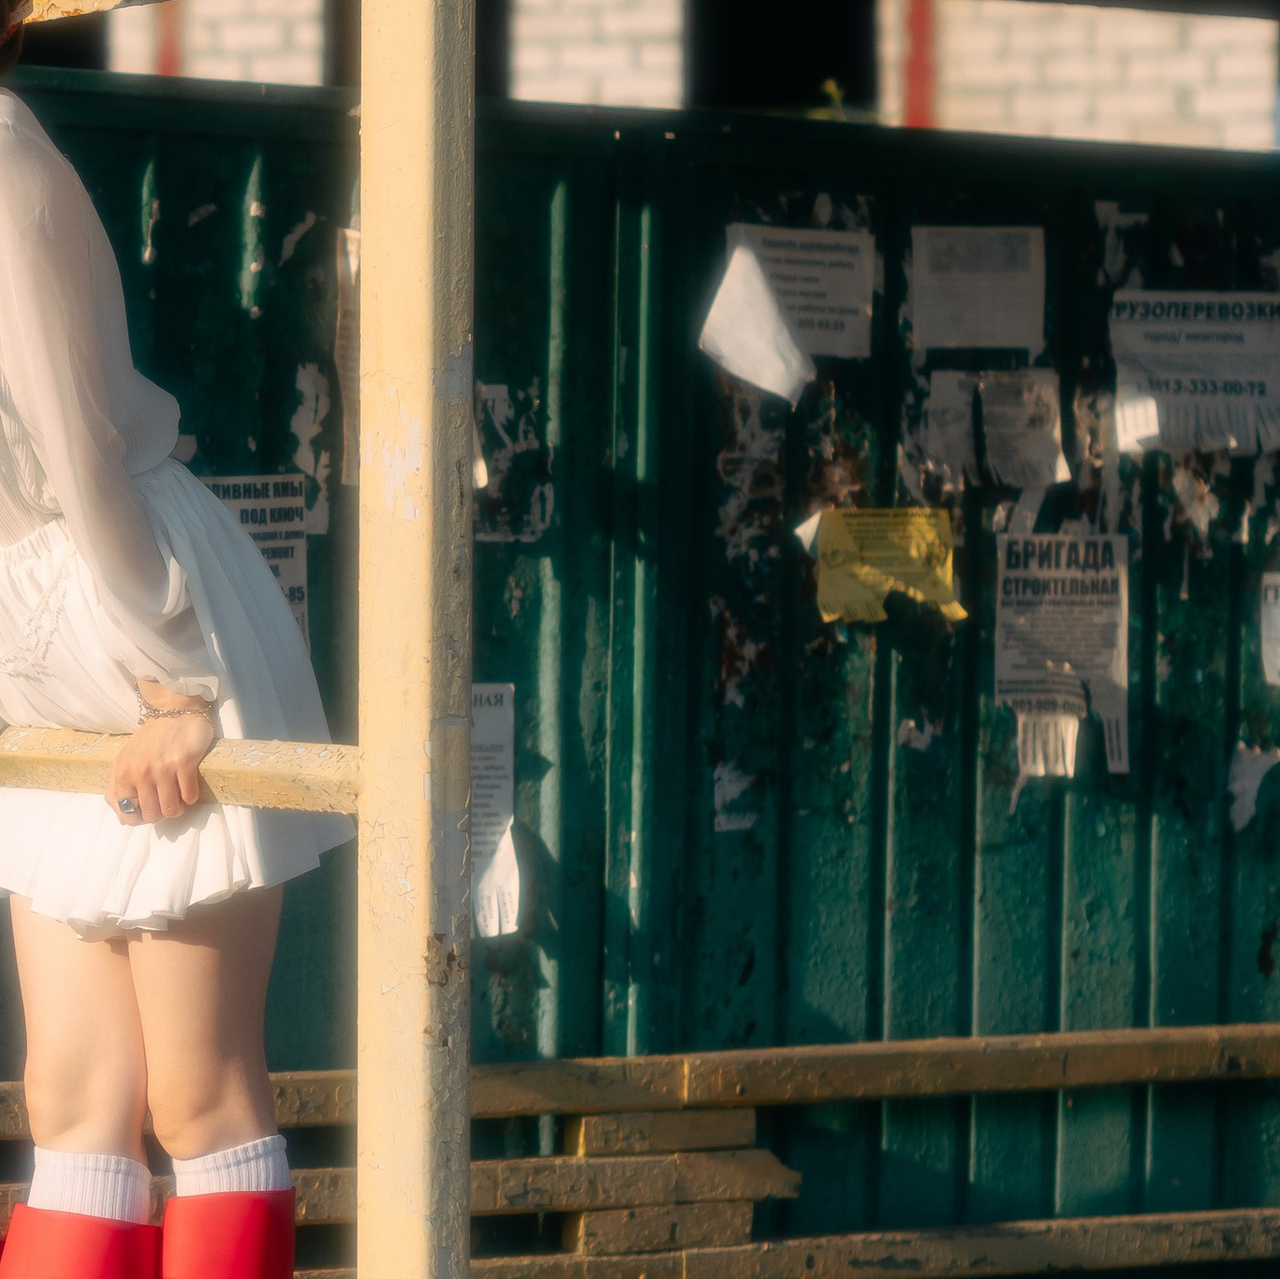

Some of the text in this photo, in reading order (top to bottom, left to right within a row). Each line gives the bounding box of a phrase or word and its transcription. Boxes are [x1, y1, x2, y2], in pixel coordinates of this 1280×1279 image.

[205, 480, 304, 500] ЛИВНЫЕ ЯМЫ
[240, 506, 305, 526] ПОД КЛЮЧ
[261, 546, 296, 561] РЕМОНТ
[1005, 538, 1115, 574] БРИГАДА
[281, 586, 305, 603] -85
[1002, 577, 1120, 597] СТРОИТЕЛЬНАЯ
